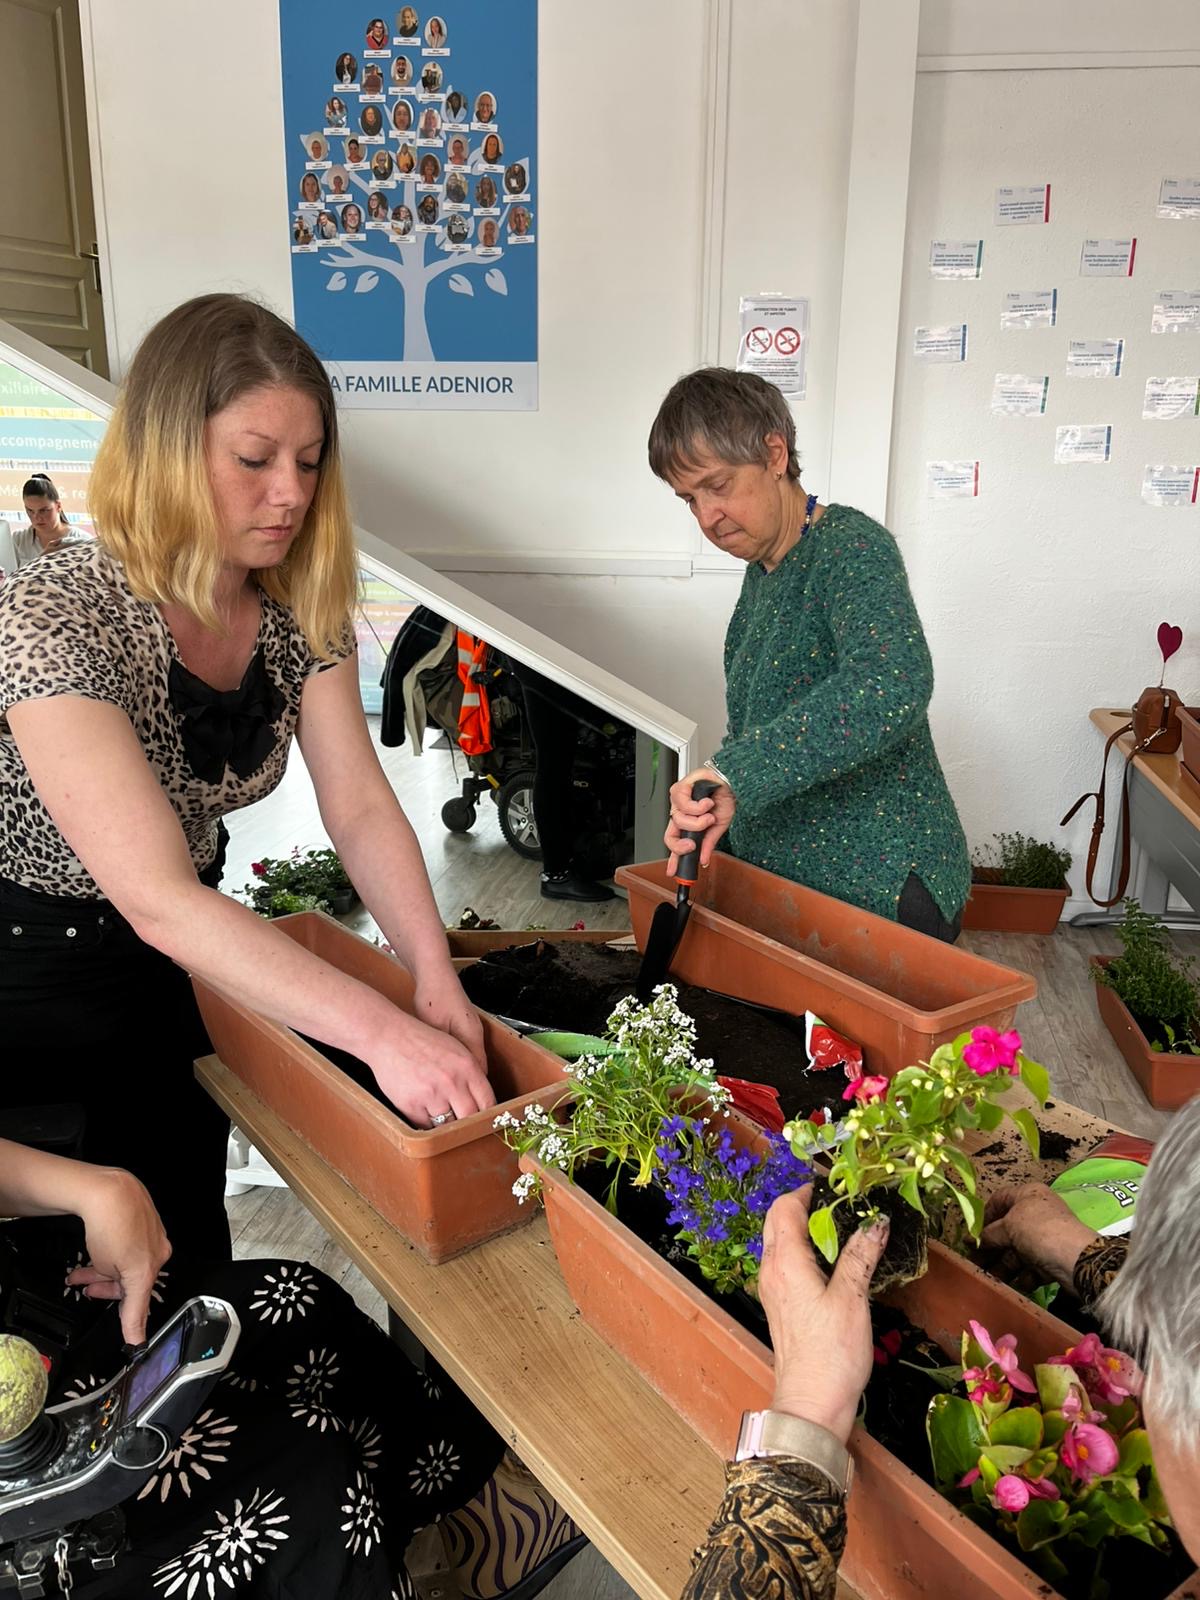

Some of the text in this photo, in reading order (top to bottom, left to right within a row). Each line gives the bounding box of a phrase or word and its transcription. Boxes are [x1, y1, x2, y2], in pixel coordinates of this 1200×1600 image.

[330, 375, 514, 394] A FAMILLE ADENIOR
[0, 435, 98, 451] ccompagnem
